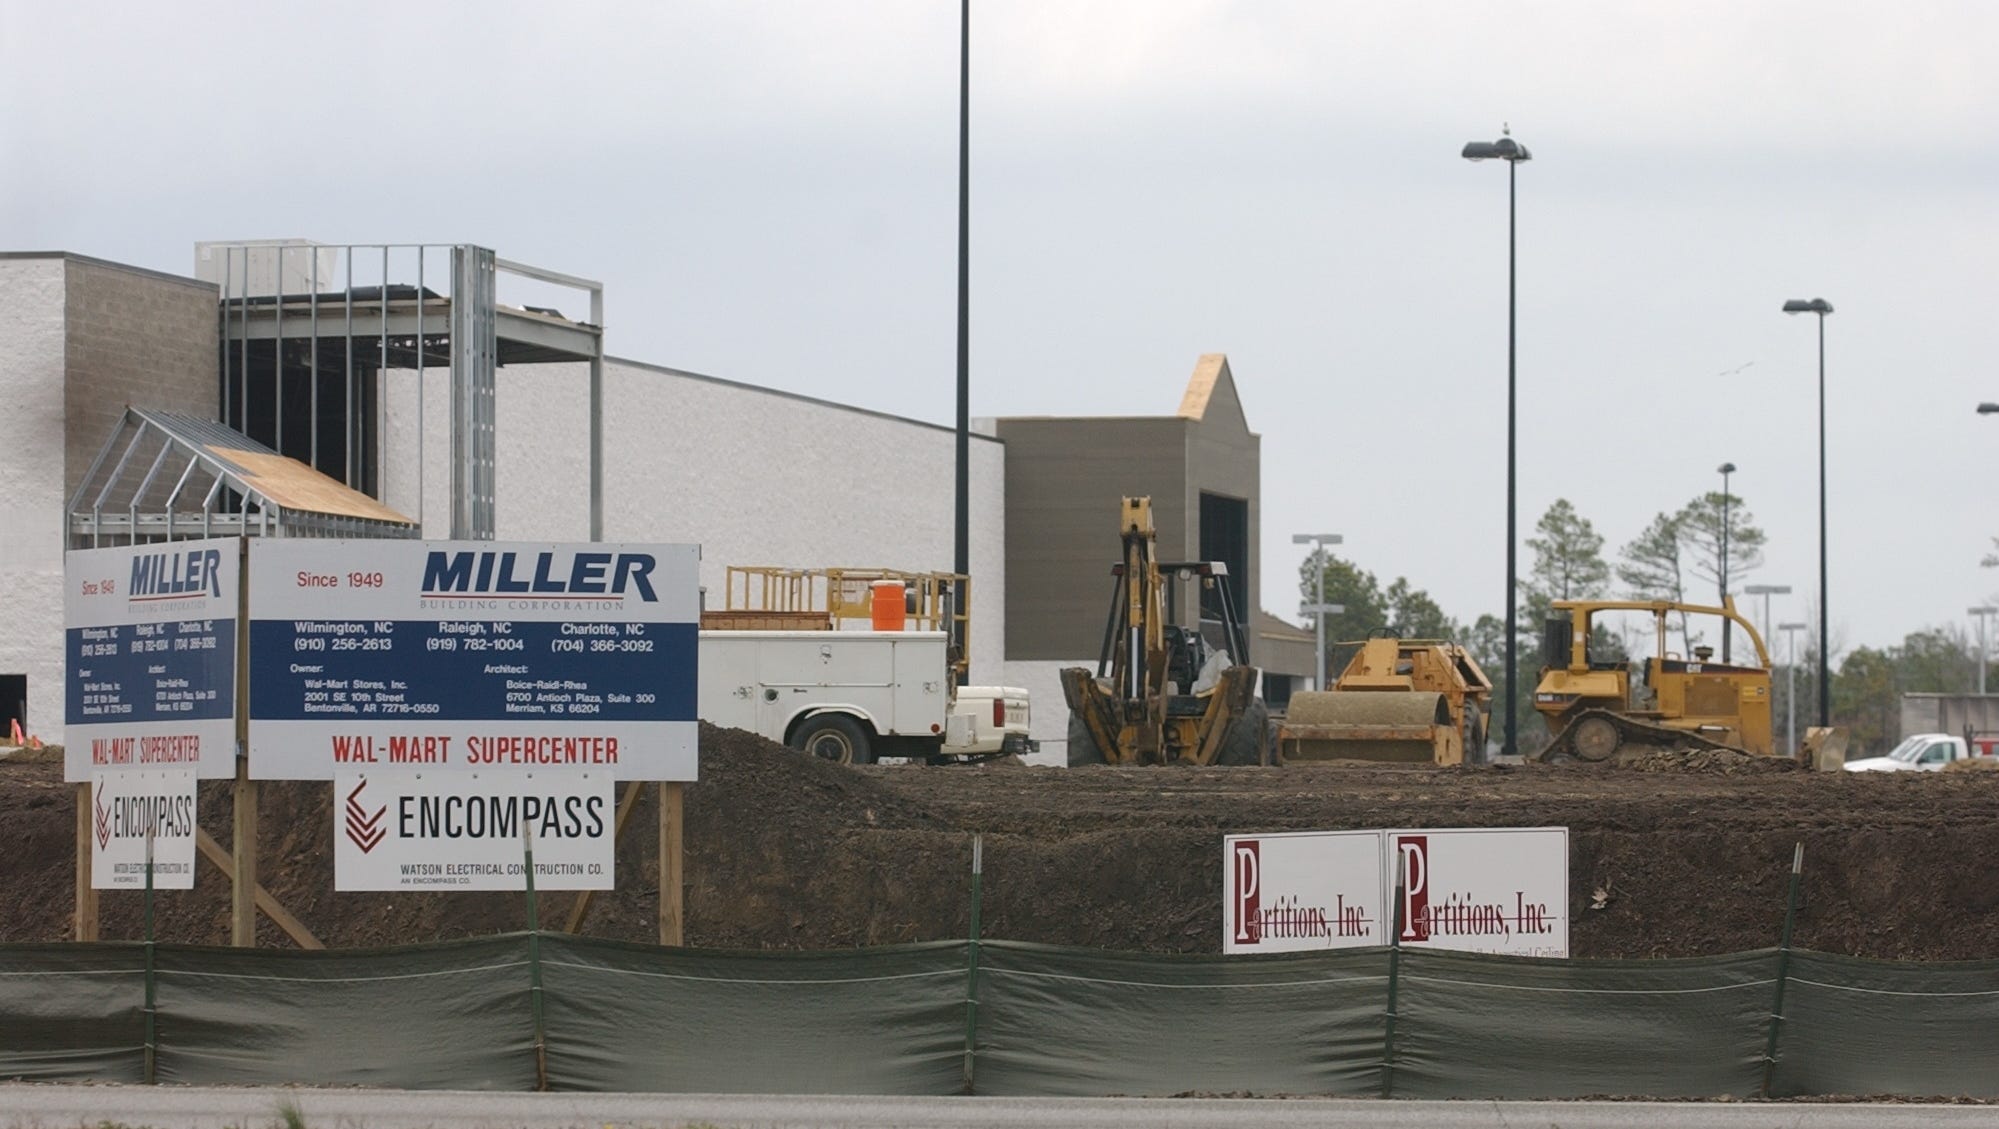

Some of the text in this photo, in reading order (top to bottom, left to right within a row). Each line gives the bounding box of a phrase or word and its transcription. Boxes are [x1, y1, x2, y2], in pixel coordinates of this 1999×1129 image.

[130, 549, 221, 598] MILLER
[297, 571, 383, 588] Since 1949
[421, 551, 659, 602] MILLER
[82, 579, 115, 595] Since 1949
[420, 600, 624, 611] BUILDING CORPORATION
[295, 622, 393, 635] Wilmington, NC
[439, 622, 512, 635] Raleigh, NC
[561, 623, 644, 636] Charlotte, NC
[294, 638, 392, 651] (910) 256-2613
[427, 638, 524, 651] (919) 782-1004
[551, 639, 653, 652] (704) 366-3092
[290, 664, 323, 673] Owner:
[484, 664, 528, 674] Architect:
[305, 680, 408, 690] Wal-Mart Stores, Inc.
[305, 693, 404, 702] 2001 SE 10th Street
[506, 693, 655, 703] 6700 Antioch Plaza, Suite 300
[304, 703, 358, 713] Bentonville,
[363, 704, 376, 712] AR
[506, 704, 600, 714] Merriam, KS 66204
[92, 735, 200, 765] WAL-MART SUPERCENTER
[333, 736, 618, 764] WAL-MART SUPERCENTER
[114, 795, 192, 838] ENCOMPASS
[400, 796, 604, 838] ENCOMPASS
[401, 864, 603, 875] WATSON ELECTRICAL CONTRUCTION CO.
[413, 877, 457, 885] ENCOMPASS
[1236, 846, 1370, 947] Partitions, Inc.
[1401, 842, 1552, 945] Partitions, Inc.
